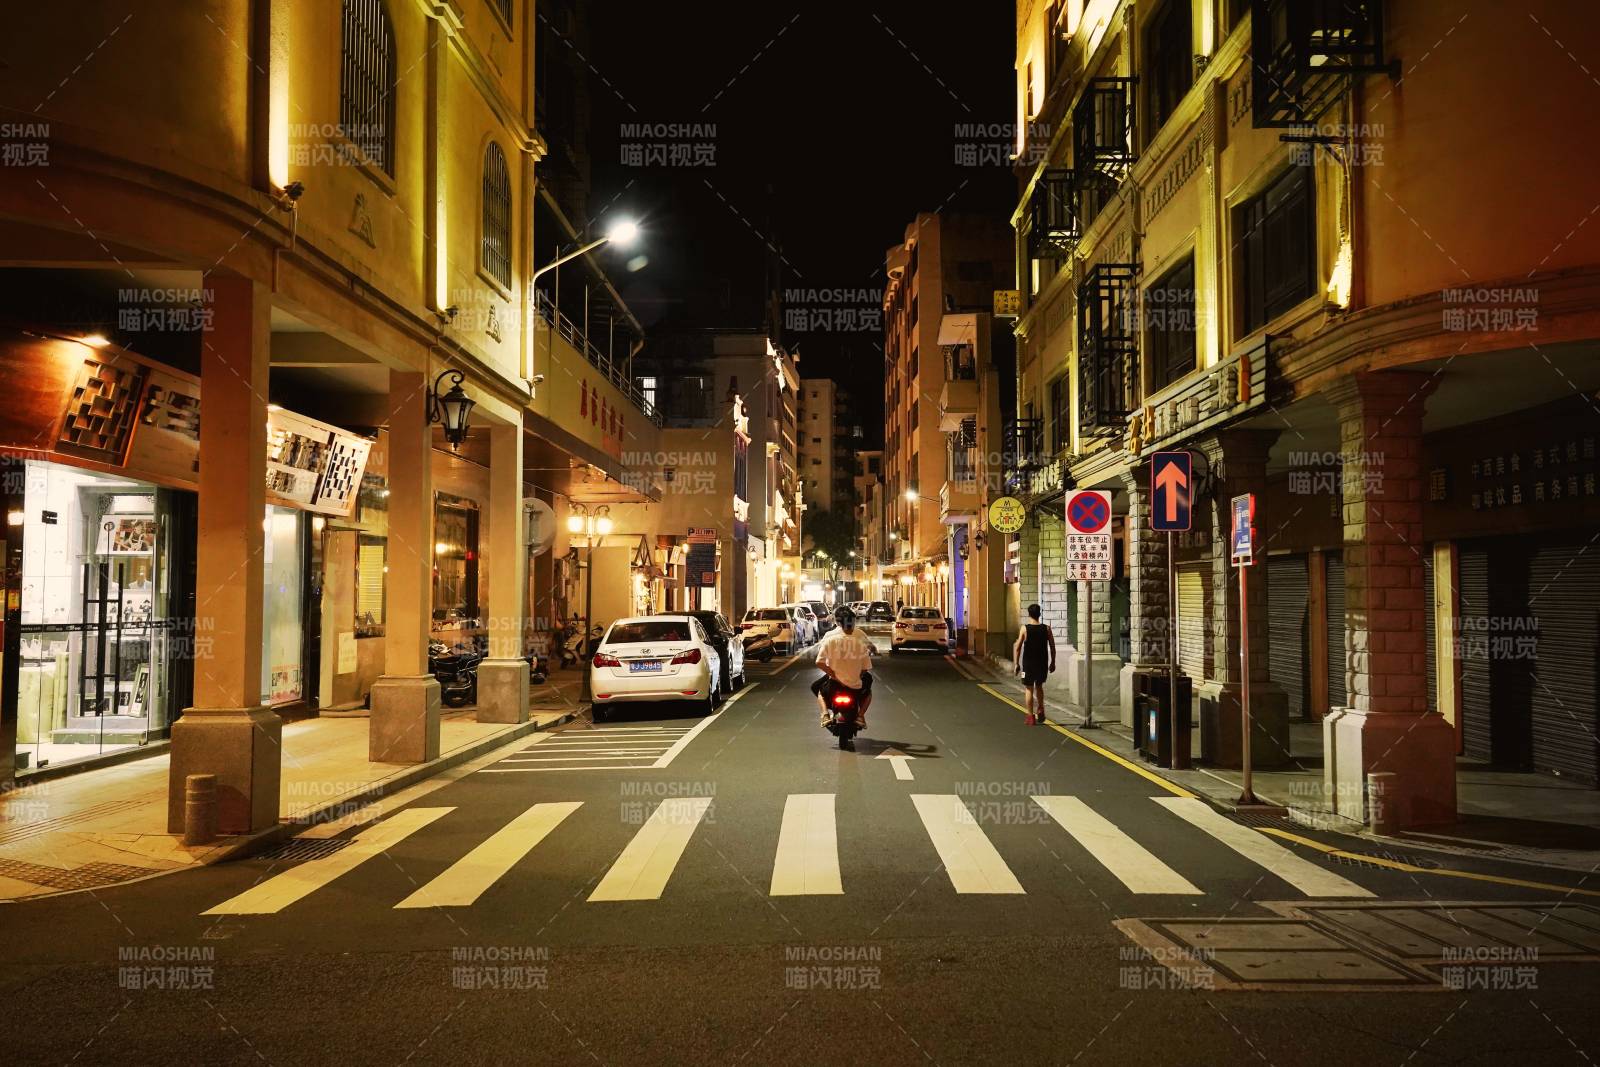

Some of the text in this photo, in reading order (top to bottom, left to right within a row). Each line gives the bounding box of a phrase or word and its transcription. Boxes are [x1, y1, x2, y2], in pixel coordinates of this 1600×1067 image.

[1069, 536, 1107, 544] 非车位禁止
[1069, 563, 1108, 571] 车辆分类
[1069, 571, 1108, 579] 入位停放
